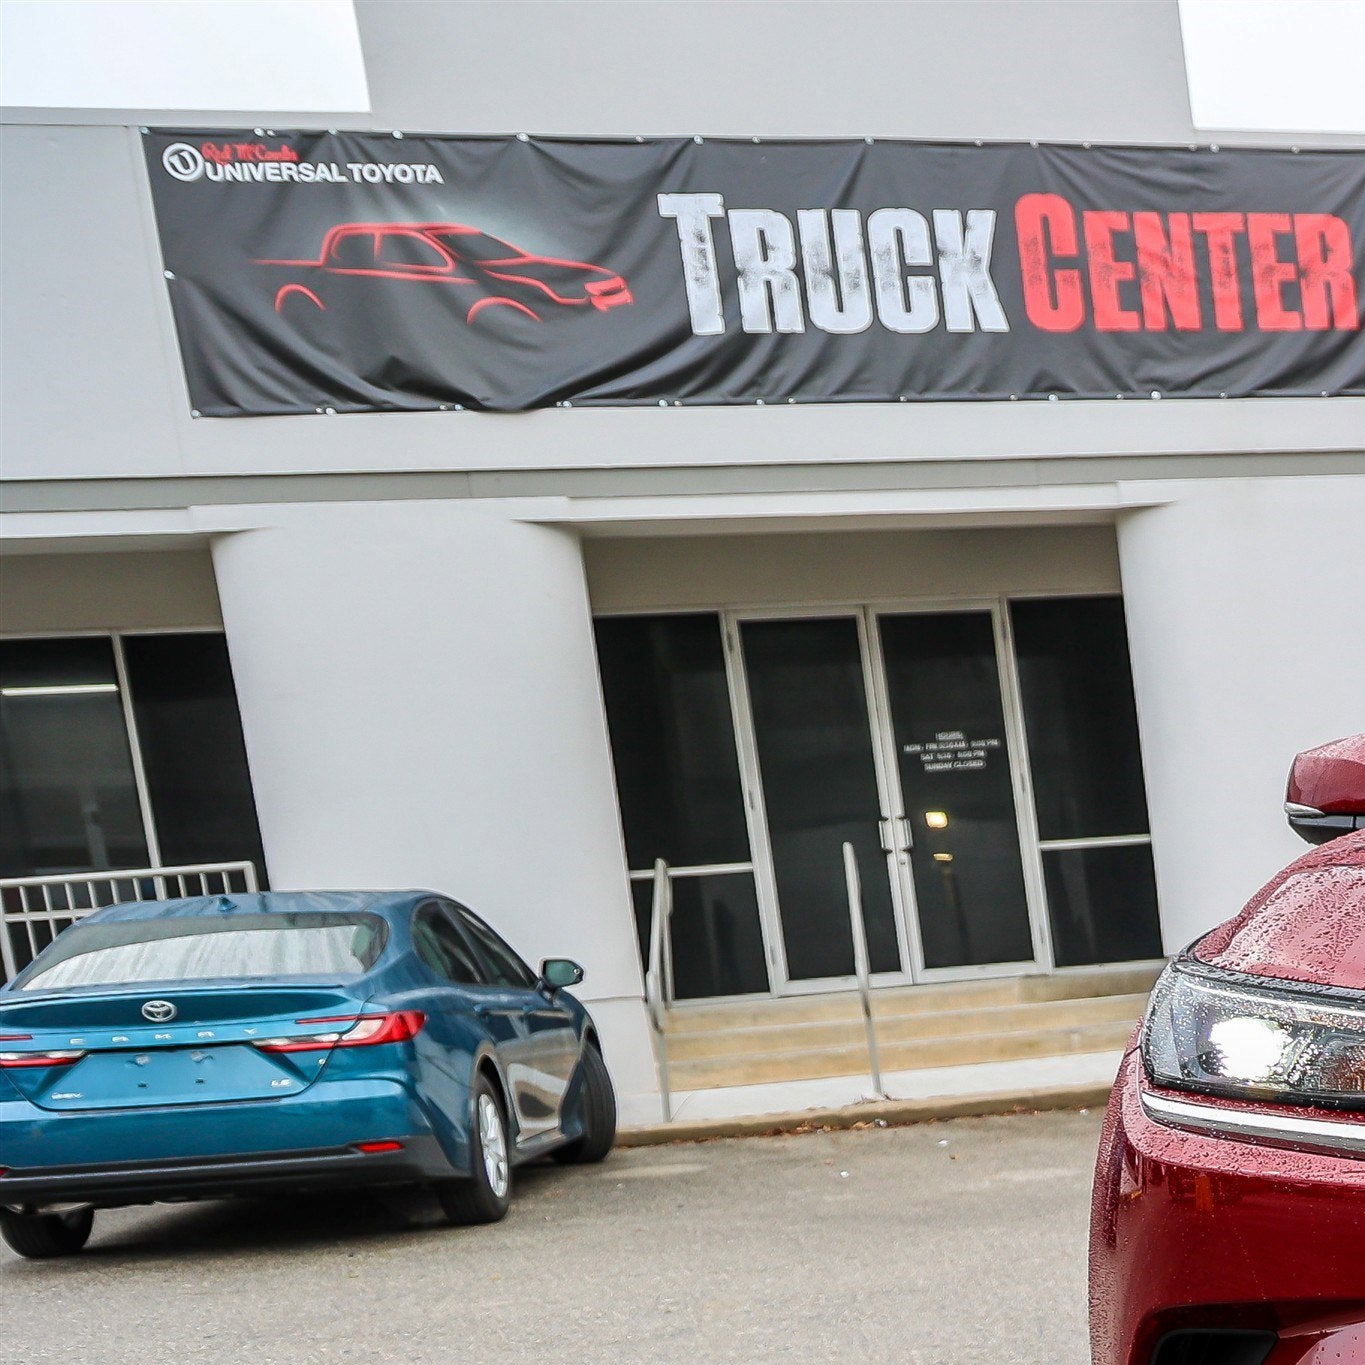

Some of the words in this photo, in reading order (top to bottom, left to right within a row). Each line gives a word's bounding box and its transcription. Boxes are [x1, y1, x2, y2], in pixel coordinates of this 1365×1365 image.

[205, 162, 348, 183] UNIVERSAL
[347, 163, 445, 184] TOYOTA
[657, 192, 1011, 336] TRUCK
[1014, 192, 1360, 333] CENTER
